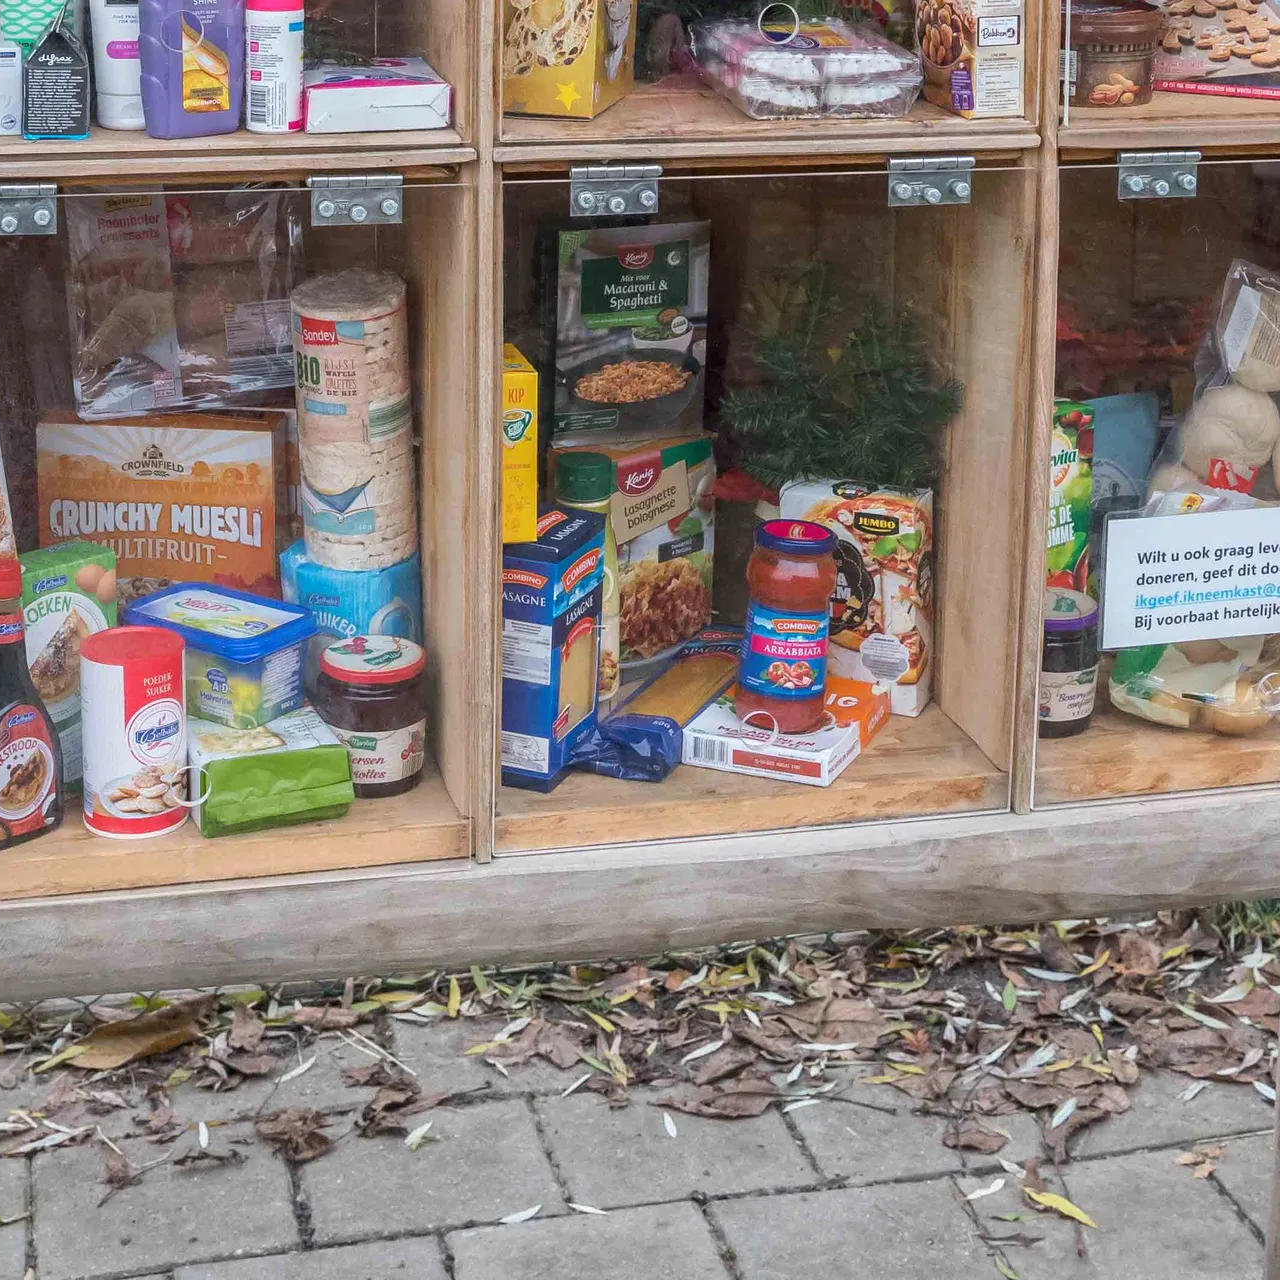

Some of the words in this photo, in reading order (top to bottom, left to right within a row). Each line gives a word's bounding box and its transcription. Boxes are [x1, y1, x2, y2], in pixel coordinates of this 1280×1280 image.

[38, 53, 73, 66] difrax
[624, 251, 648, 265] Kania
[604, 281, 656, 295] Macaroni
[659, 279, 669, 291] &
[610, 293, 662, 310] Spaghetti
[303, 329, 336, 343] Sondey
[324, 358, 356, 370] RIJST
[508, 388, 525, 403] KIP
[121, 459, 185, 473] CROWNFIELD
[624, 468, 654, 490] Kania
[624, 485, 677, 517] Lasagnette
[49, 499, 164, 537] CRUNCHY
[627, 499, 676, 529] bolognese
[1059, 504, 1072, 523] DE
[551, 518, 587, 540] LASAGNE
[858, 517, 896, 529] JUMBO
[1137, 550, 1167, 564] Wilt
[1171, 550, 1179, 562] u
[1184, 545, 1211, 560] ook
[1213, 542, 1254, 561] graag
[502, 572, 542, 585] COMBINO
[566, 555, 596, 586] COMBINO
[1135, 570, 1199, 587] doneren,
[1201, 563, 1234, 584] geef
[1237, 564, 1257, 577] dit
[25, 595, 72, 629] OEKEN
[566, 595, 594, 625] LASAGNE
[1133, 614, 1154, 631] Bij
[1156, 608, 1220, 627] voorbaat
[1222, 602, 1280, 620] hartelijk
[777, 623, 816, 631] COMBINO
[763, 645, 822, 655] ARRABBIATA
[146, 684, 172, 697] SUIKER
[200, 691, 232, 705] Halvarine
[351, 755, 385, 766] ersen
